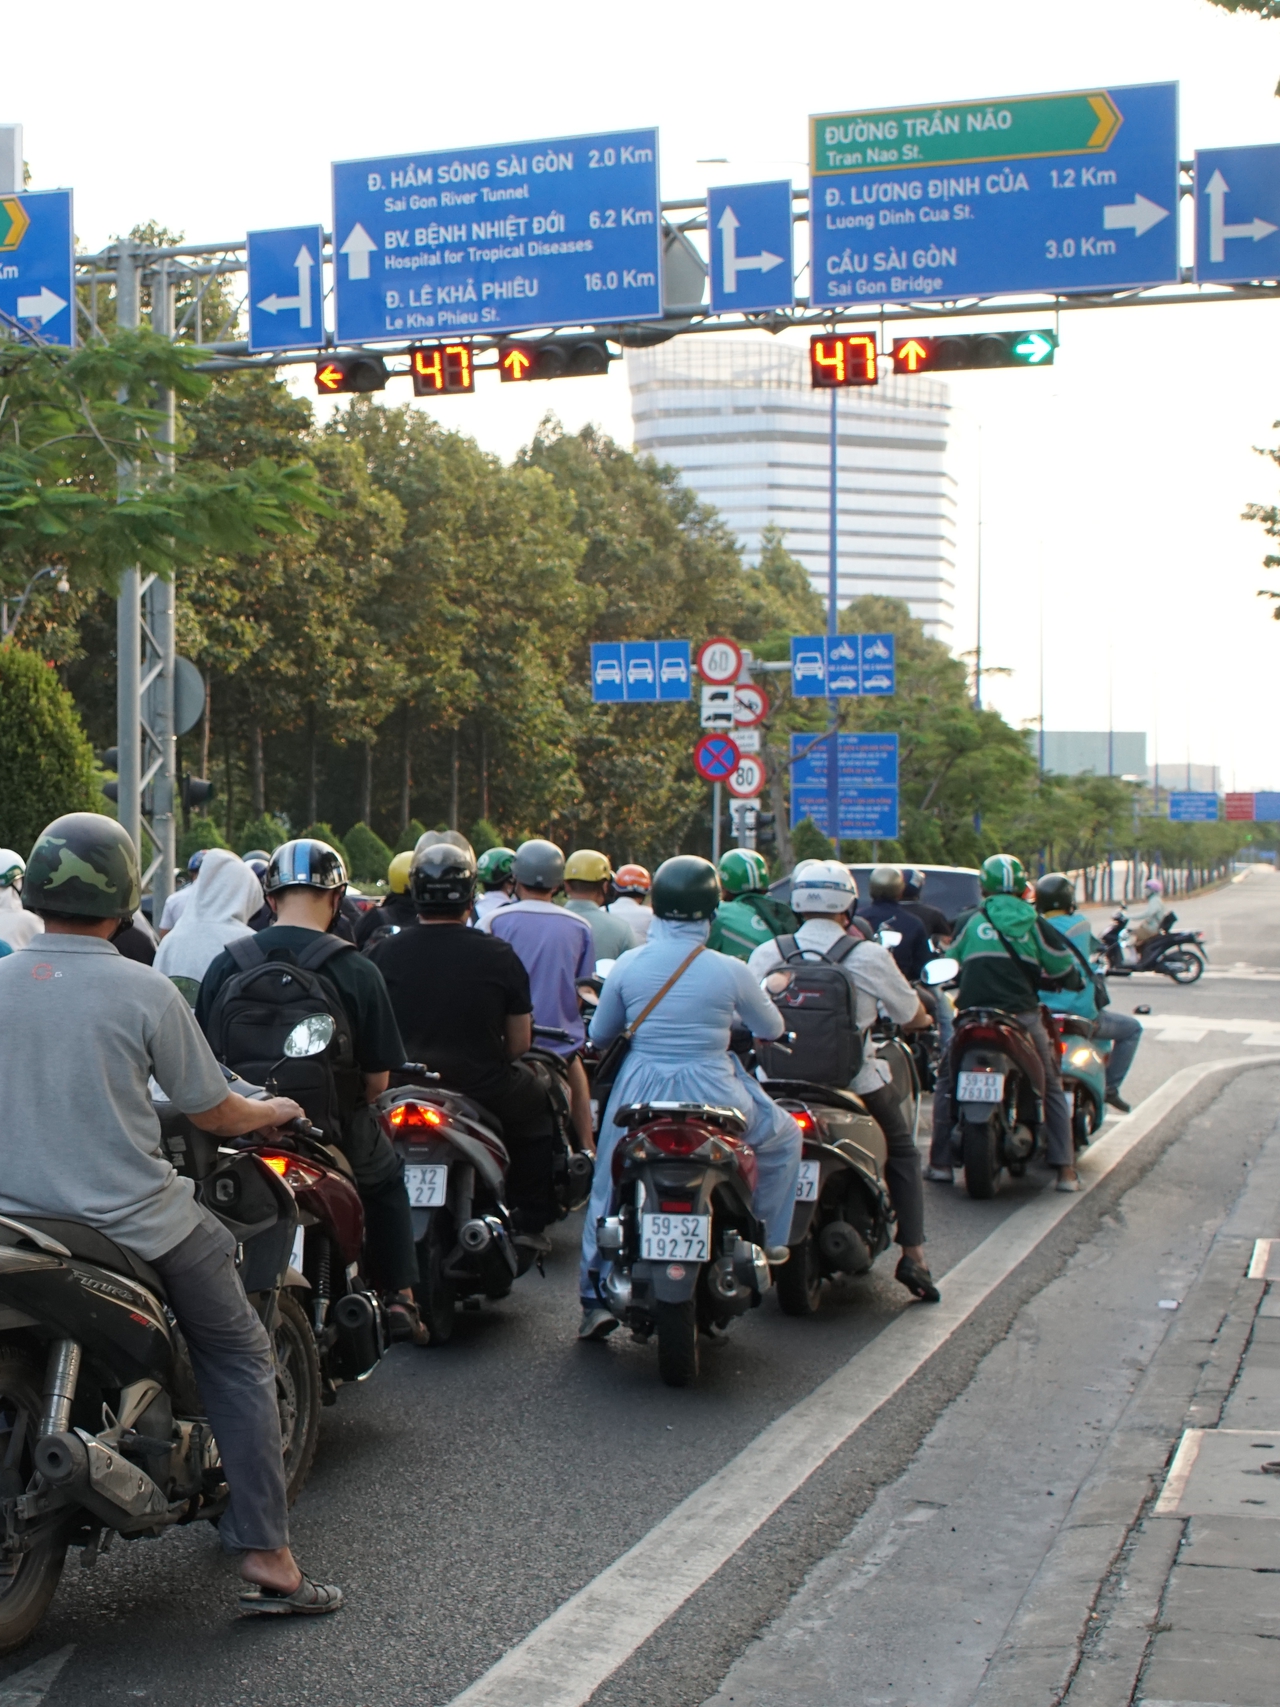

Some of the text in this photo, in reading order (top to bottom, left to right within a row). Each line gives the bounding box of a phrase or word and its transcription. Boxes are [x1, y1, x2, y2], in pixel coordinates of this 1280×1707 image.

[825, 110, 1012, 146] ĐƯỜNG TRẦN NÃO
[368, 147, 652, 192] Đ. HẦM SÔNG SÀI GÒN 2.0 Km
[826, 144, 923, 168] Tran Nao St.
[385, 184, 529, 213] Sai Gon River Tunnel
[826, 167, 1117, 208] Đ. LƯƠNG ĐỊNH CỦA 1.2 Km
[385, 208, 653, 250] BV. BỆNH NHIỆT ĐỚI 6.2 Km
[826, 203, 975, 231] Luong Dinh Cua St.
[385, 237, 593, 271] Hospital for Tropical Diseases
[826, 238, 1117, 276] CẦU SÀI GÒN 3.0 Km
[386, 270, 655, 309] Đ. LÊ KHẢ PHIÊU 16.0 Km
[827, 275, 943, 297] Sai Gon Bridge
[386, 307, 500, 330] Le Kha Phieu St.
[416, 347, 469, 389] 47
[815, 337, 874, 381] 47
[708, 650, 729, 672] 60
[735, 767, 754, 786] 80
[652, 1217, 699, 1237] 59-S2
[645, 1238, 705, 1259] 192.72
